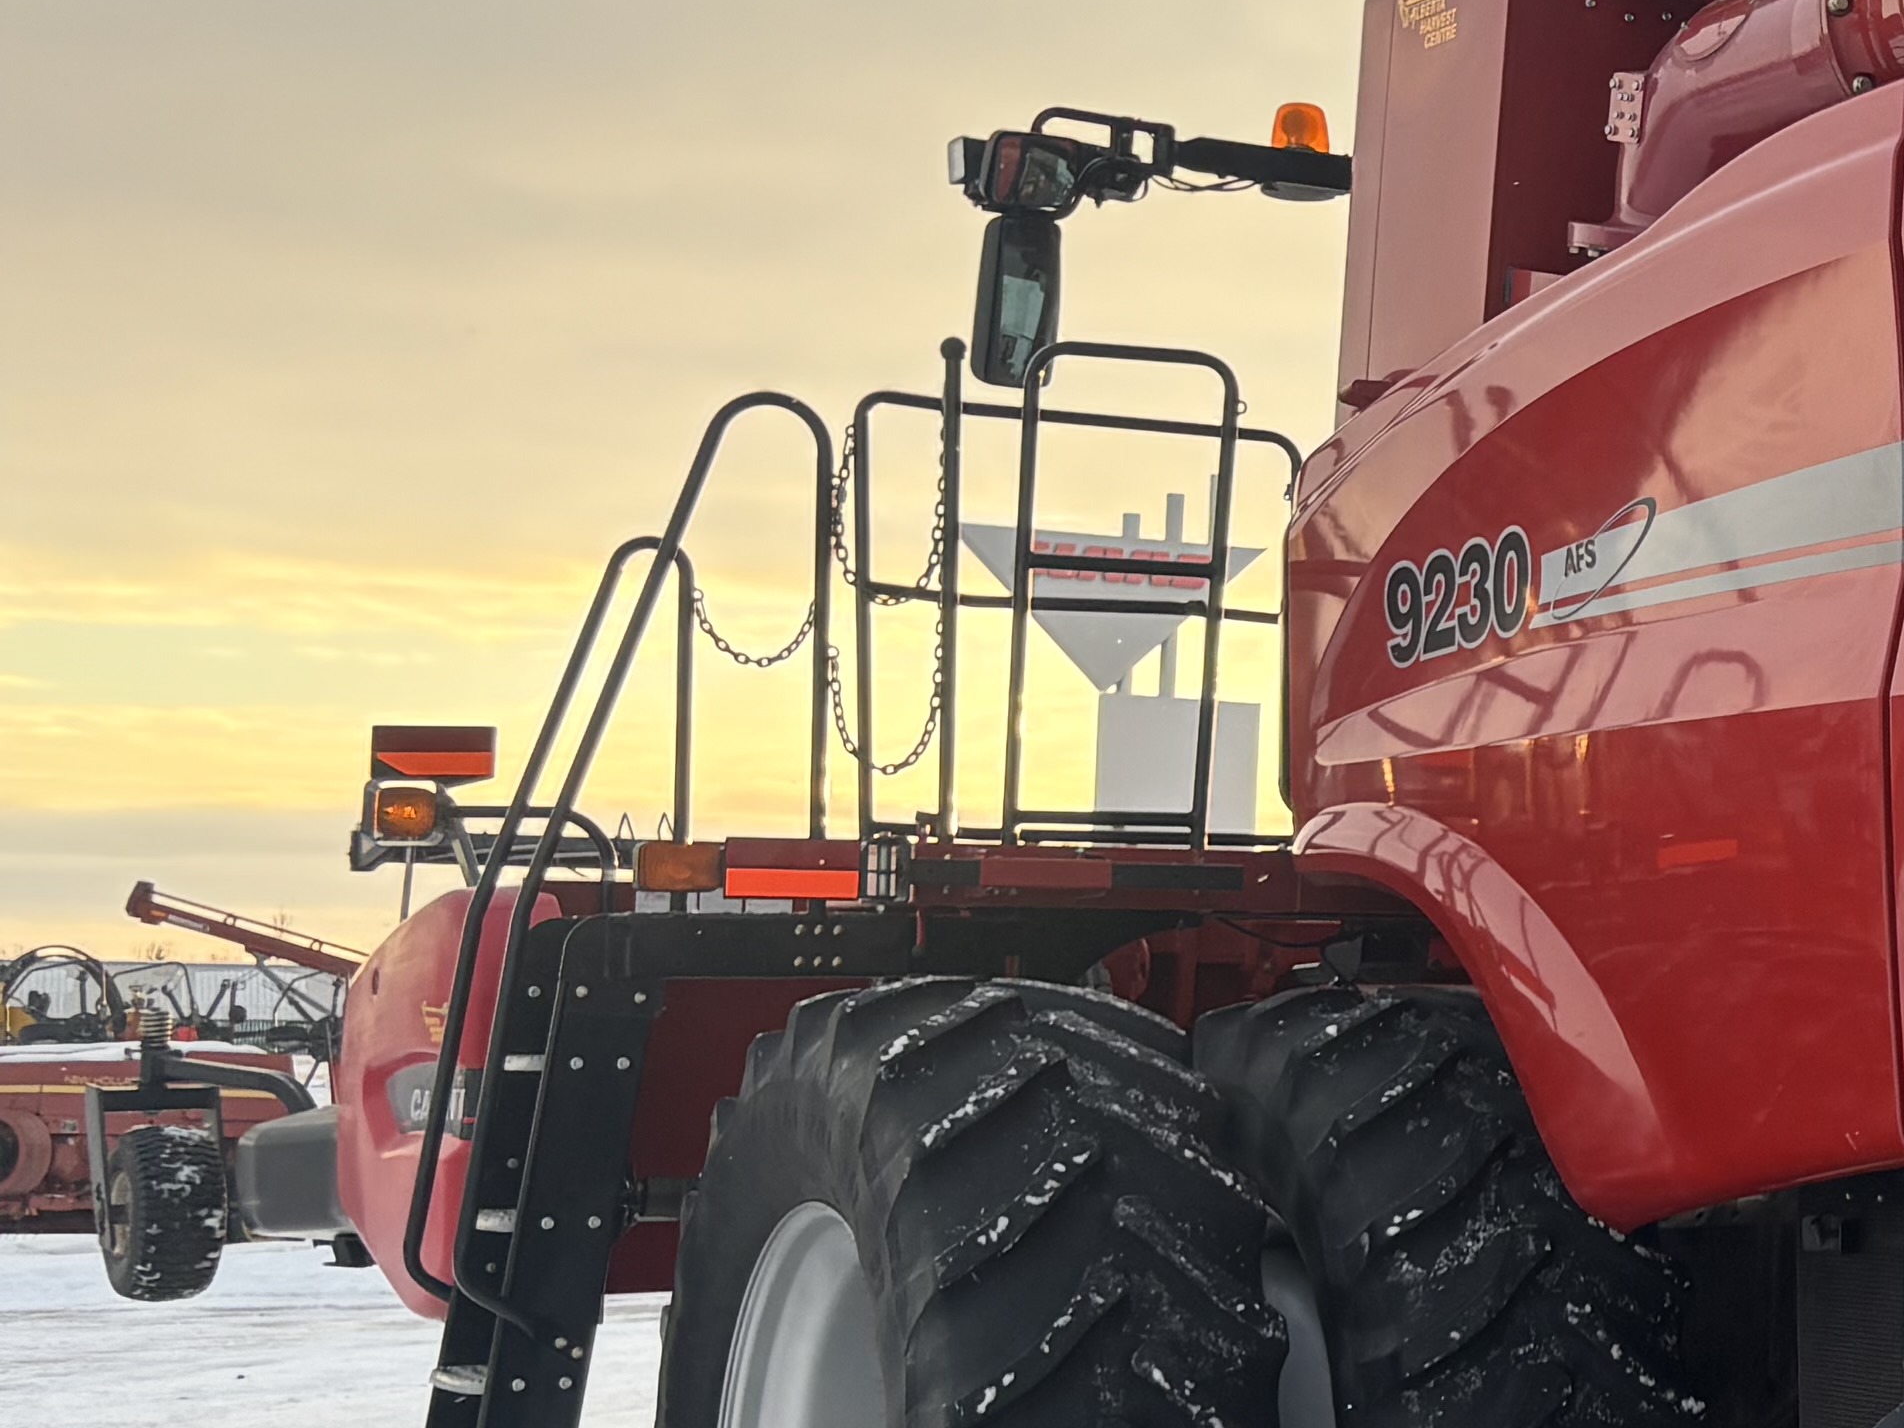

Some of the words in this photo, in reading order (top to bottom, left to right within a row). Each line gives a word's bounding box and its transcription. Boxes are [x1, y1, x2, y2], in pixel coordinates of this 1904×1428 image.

[1419, 8, 1457, 35] HARVEST
[1425, 25, 1457, 48] CENTRE
[1564, 539, 1597, 577] AFS
[1385, 524, 1532, 668] 9230
